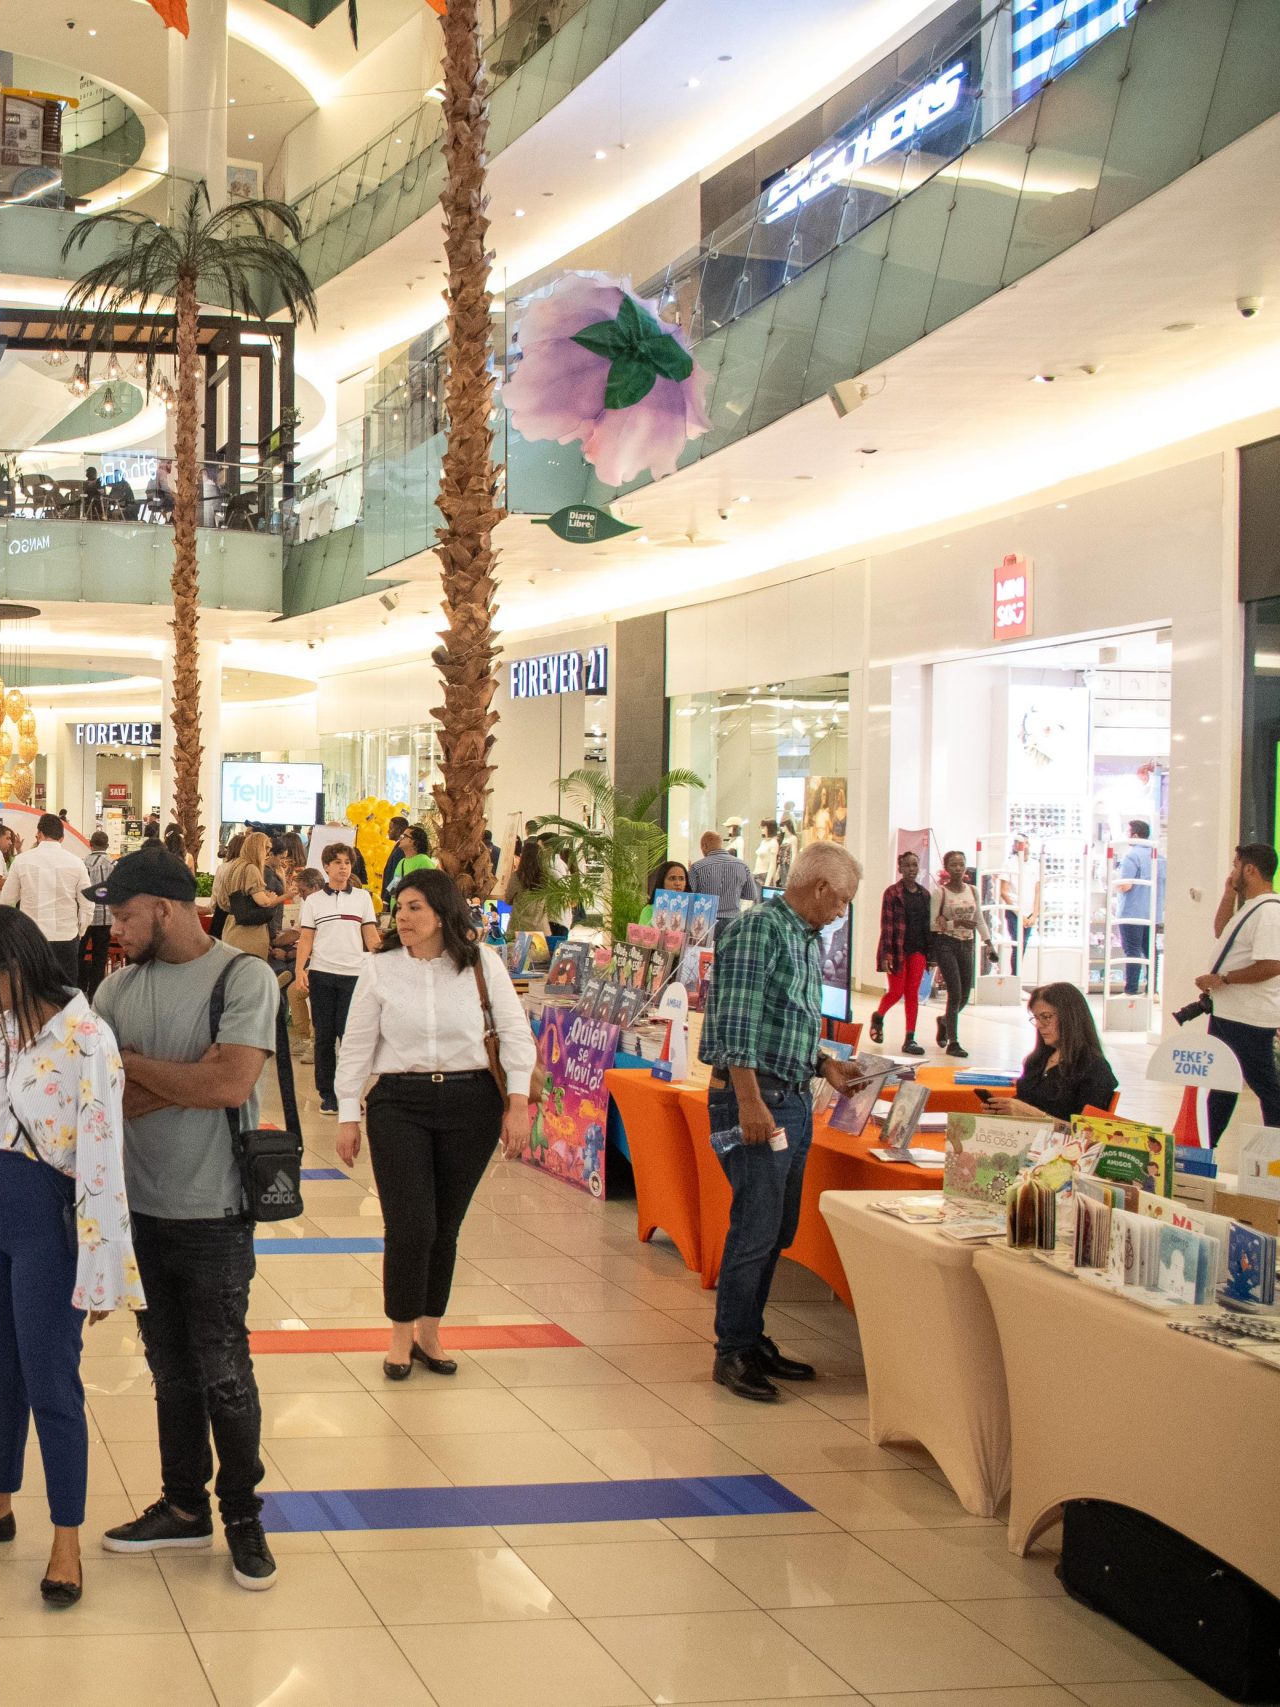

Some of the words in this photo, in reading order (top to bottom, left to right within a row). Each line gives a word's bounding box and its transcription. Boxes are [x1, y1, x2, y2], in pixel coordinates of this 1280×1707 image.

[568, 519, 592, 528] Libre
[569, 511, 595, 521] Diario
[510, 652, 582, 699] FOREVER
[587, 646, 606, 690] 21
[76, 722, 154, 745] FOREVER
[109, 788, 126, 796] SALE
[564, 1016, 608, 1052] ¿Quién
[577, 1047, 589, 1063] se
[1172, 1049, 1215, 1065] PEKE'S
[1174, 1062, 1209, 1077] ZONE
[976, 1132, 992, 1144] LOS
[993, 1136, 1018, 1149] OSOS
[1099, 1150, 1118, 1159] OMOS
[1106, 1159, 1132, 1169] AMIGOS
